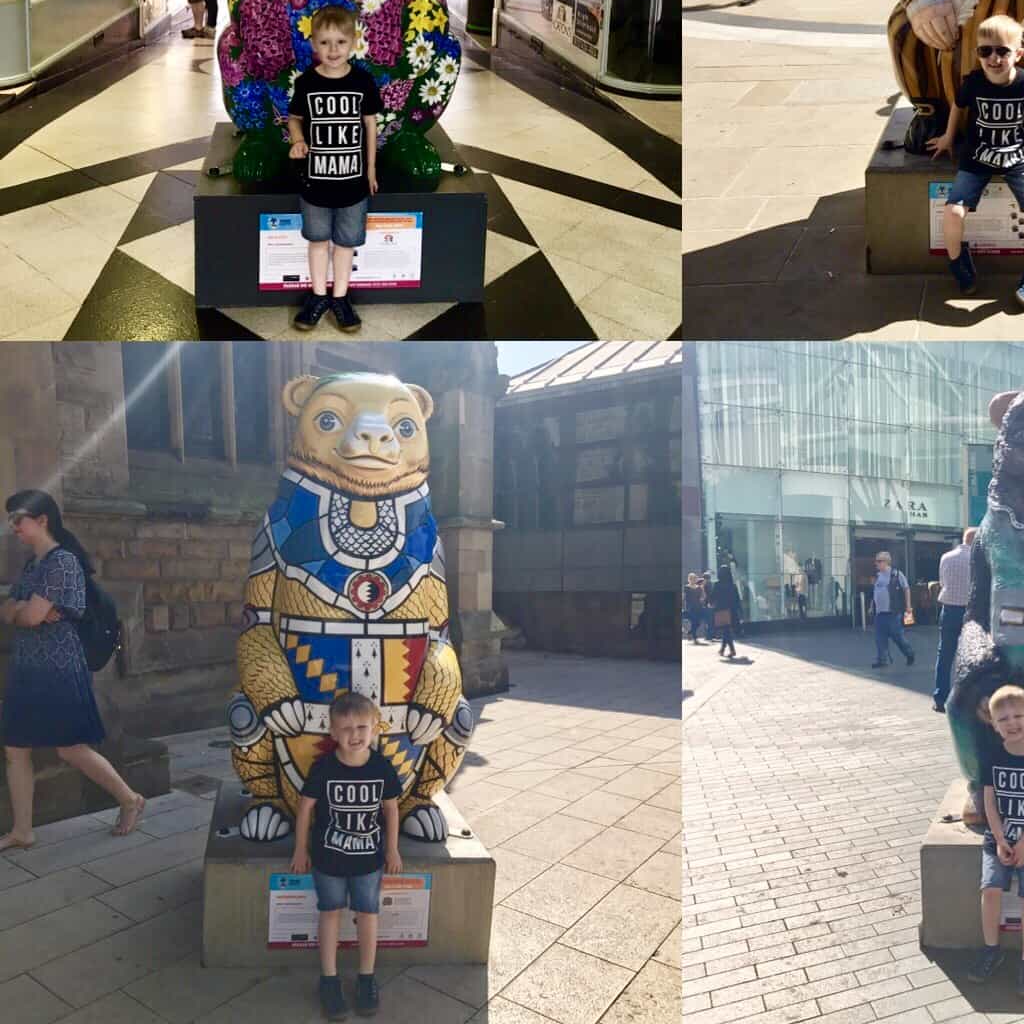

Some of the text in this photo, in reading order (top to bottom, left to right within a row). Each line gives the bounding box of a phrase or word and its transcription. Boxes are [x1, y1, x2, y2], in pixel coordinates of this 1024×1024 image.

[314, 96, 358, 115] COOL
[981, 102, 1022, 120] COOL
[315, 125, 359, 145] LIKE
[314, 154, 358, 175] MAMA
[334, 784, 378, 803] COOL
[331, 831, 375, 850] MAMA
